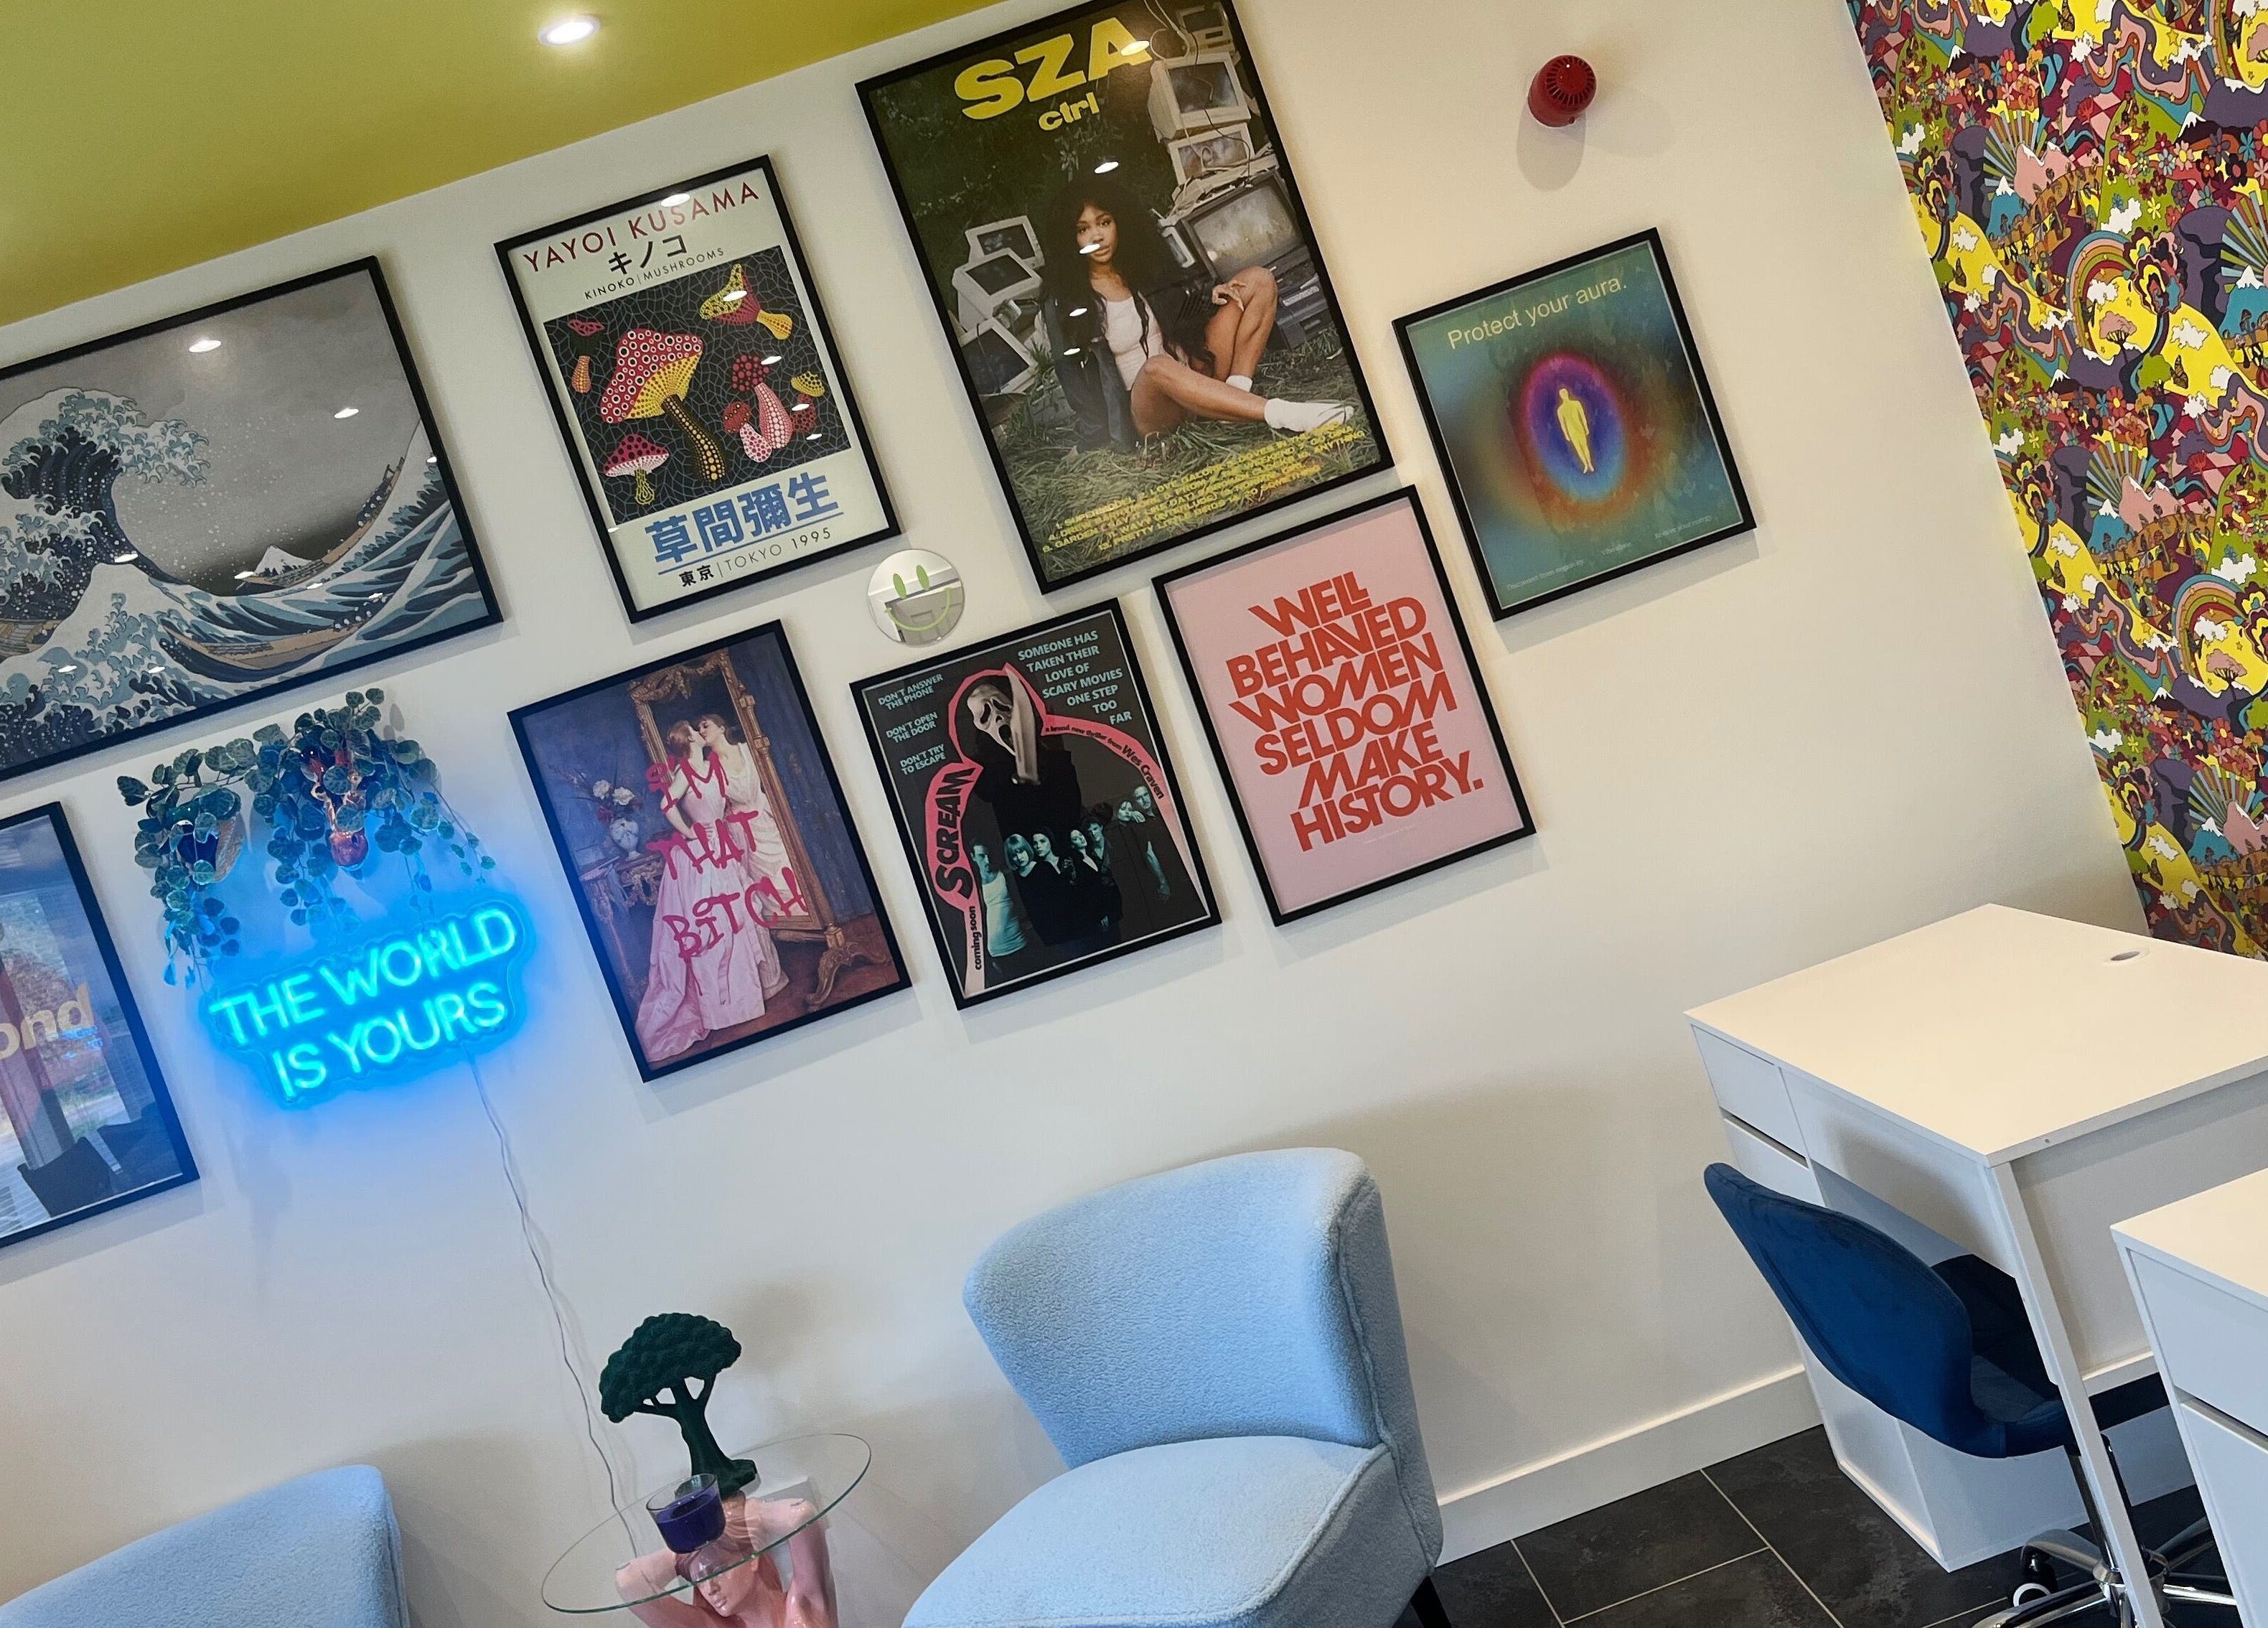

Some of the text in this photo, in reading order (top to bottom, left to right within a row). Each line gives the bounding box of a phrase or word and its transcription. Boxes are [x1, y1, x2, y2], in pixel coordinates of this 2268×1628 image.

[954, 17, 1153, 120] SZA
[1039, 92, 1100, 131] ctrl
[523, 182, 759, 272] YAYOI KUSAMA
[584, 248, 724, 299] KINOKO MUSHROOMS
[609, 235, 687, 274] キノコ
[1447, 278, 1627, 350] Protect your aura.
[645, 472, 838, 563] 草間彌生
[725, 527, 830, 571] TOKYO 1995
[679, 565, 714, 587] 東京
[1248, 571, 1372, 637] WELL
[1018, 630, 1098, 661] SOMEONE HAS
[1026, 645, 1100, 673] TAKEN THEIR
[1226, 597, 1426, 698] BEHAVED
[878, 673, 943, 706] DON'T ANSWER
[1042, 668, 1123, 699] SCARY MOVIES
[1045, 663, 1090, 683] LOVE OF
[1228, 632, 1445, 731] WOMEN
[886, 686, 934, 711] THE PHONE
[1067, 684, 1118, 706] ONE STEP
[1092, 700, 1117, 714] TOO
[886, 711, 938, 739] DON'T OPEN
[892, 721, 937, 744] THE DOOR
[1109, 711, 1132, 725] FAR
[1254, 670, 1457, 775] SELDOM
[900, 744, 945, 768] DON'T TRY
[901, 752, 946, 775] TO ESCAPE
[1121, 744, 1143, 766] Wes
[1140, 764, 1164, 800] Craven
[1298, 720, 1444, 810] MAKE
[1290, 750, 1484, 852] HISTORY.
[647, 810, 759, 880] THAT
[934, 767, 976, 900] SCREAM
[970, 932, 983, 970] coming
[210, 907, 517, 1047] THE WORLD
[272, 982, 508, 1100] IS YOURS
